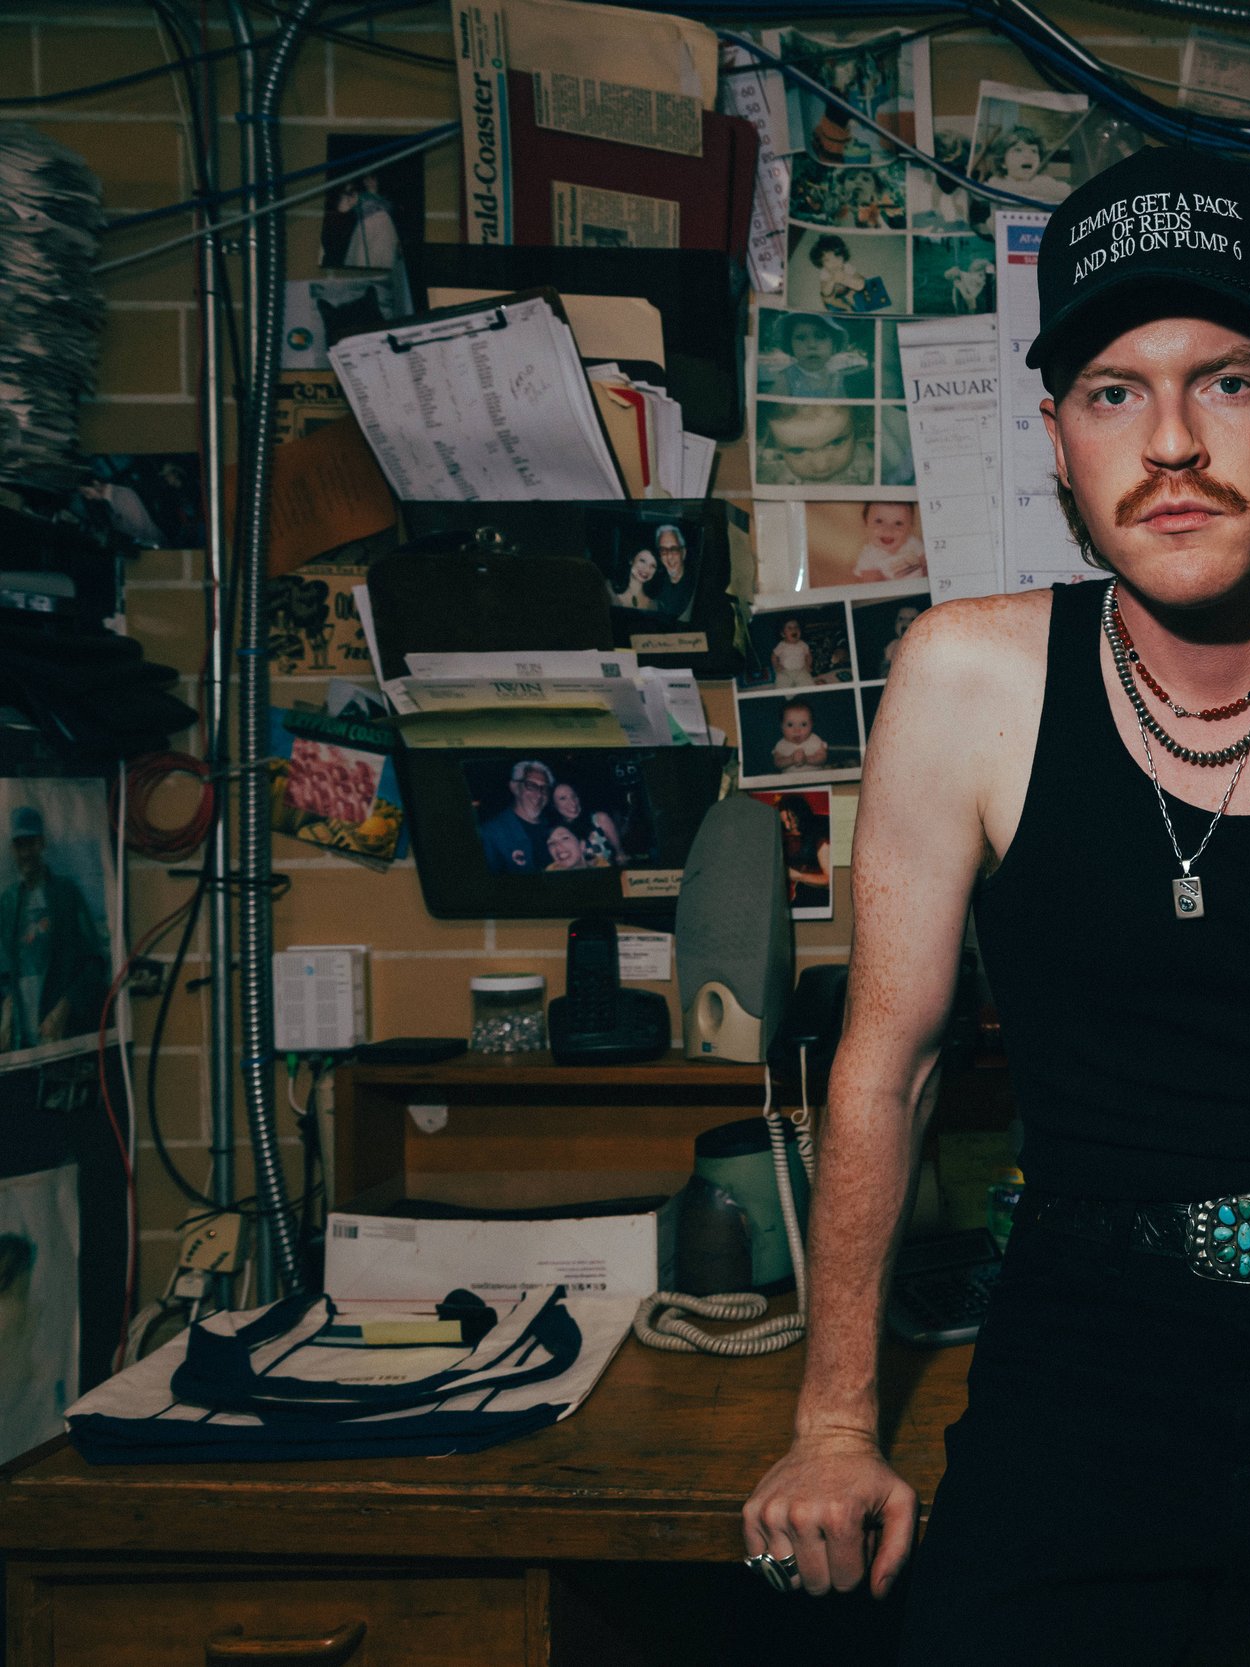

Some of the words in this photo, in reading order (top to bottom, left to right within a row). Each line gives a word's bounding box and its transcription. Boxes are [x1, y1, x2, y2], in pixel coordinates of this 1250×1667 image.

[473, 72, 498, 245] rald-Coaster
[1069, 199, 1128, 246] LEMME
[1132, 192, 1171, 216] GET
[1175, 193, 1190, 212] A
[1194, 193, 1243, 220] PACK
[1112, 217, 1134, 242] OF
[1139, 212, 1192, 234] REDS
[1073, 248, 1107, 285] AND
[1110, 239, 1136, 264] $10
[1140, 231, 1169, 252] ON
[1174, 230, 1229, 254] PUMP
[1233, 240, 1243, 261] 6
[1013, 343, 1020, 352] 3
[913, 378, 997, 403] JANUAR
[1016, 421, 1029, 431] 10
[1019, 497, 1030, 507] 17
[1020, 575, 1033, 584] 24
[490, 682, 543, 692] TWIN
